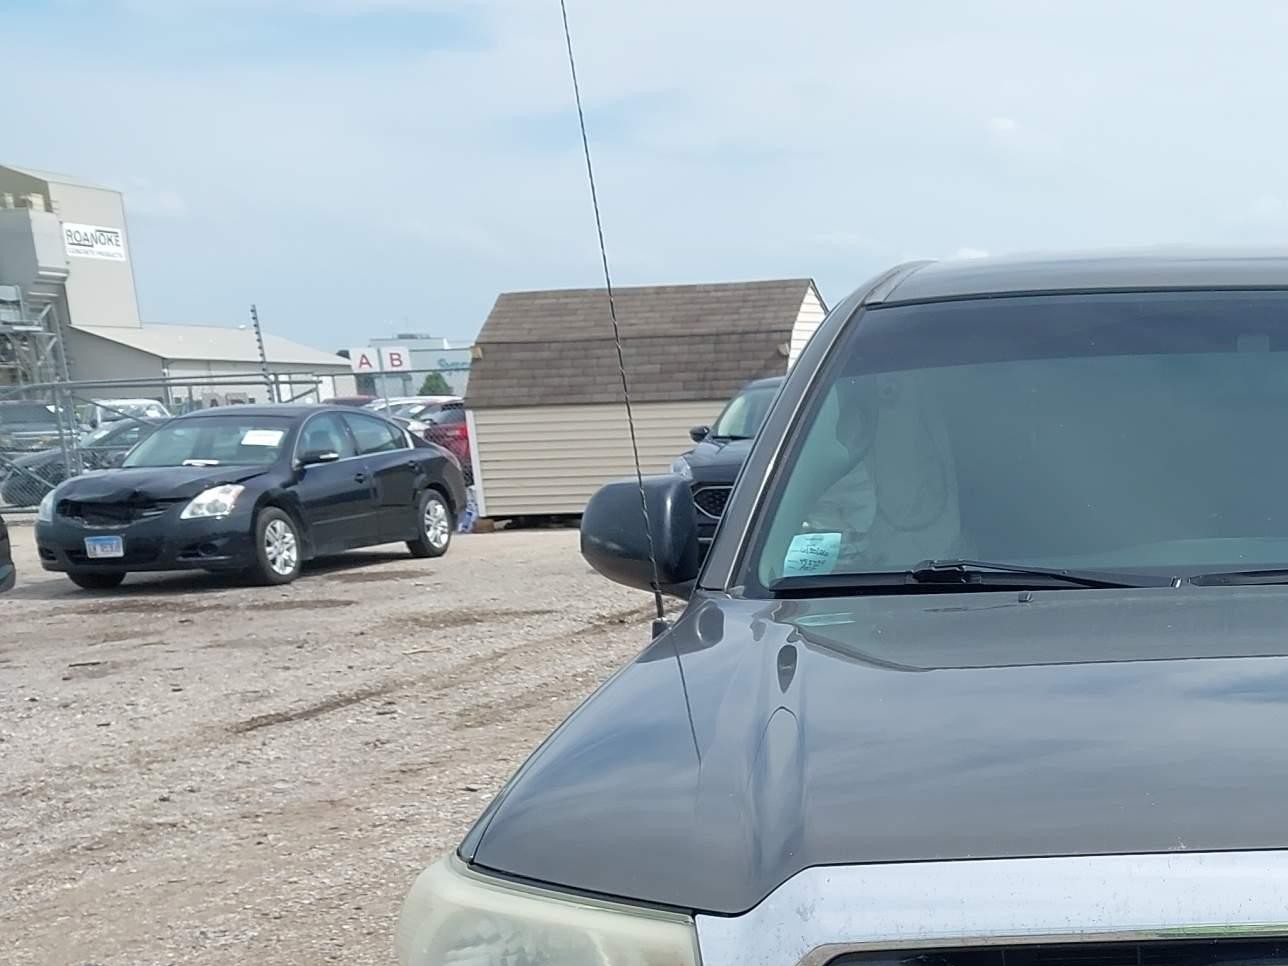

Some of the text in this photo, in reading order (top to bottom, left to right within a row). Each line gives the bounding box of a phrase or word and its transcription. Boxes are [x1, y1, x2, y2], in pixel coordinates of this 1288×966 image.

[65, 229, 121, 247] ROANOKE
[358, 353, 373, 368] A
[389, 352, 403, 368] B
